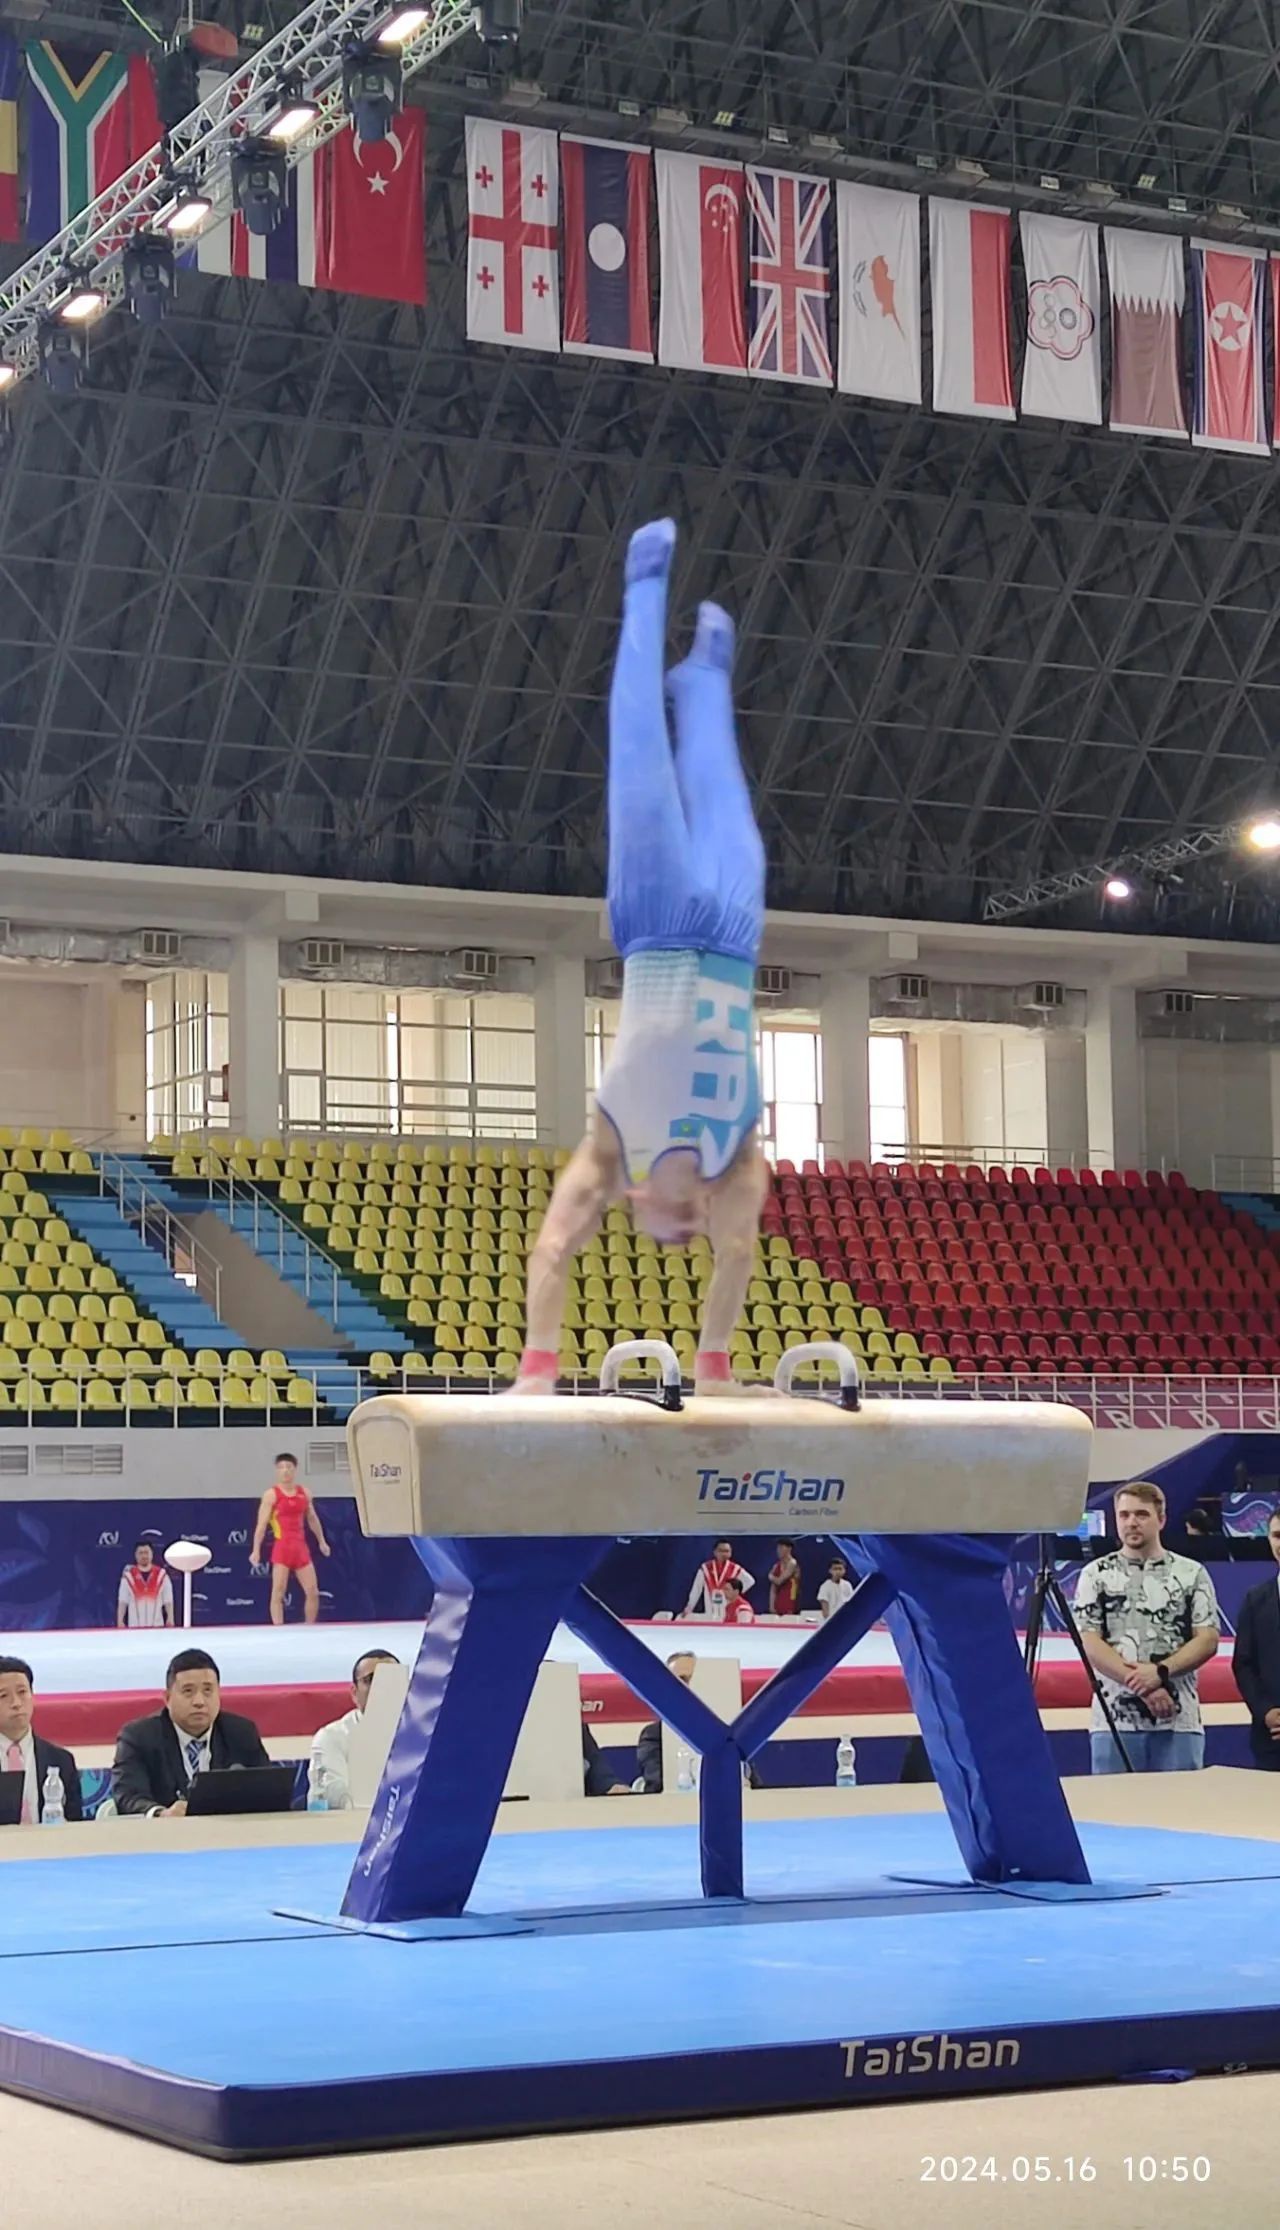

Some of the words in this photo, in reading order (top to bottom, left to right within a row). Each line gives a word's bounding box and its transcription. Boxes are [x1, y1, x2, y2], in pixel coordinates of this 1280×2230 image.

[697, 1469, 845, 1501] TaiShan
[363, 1784, 401, 1877] TaiShan
[840, 2034, 1021, 2078] TaiShan
